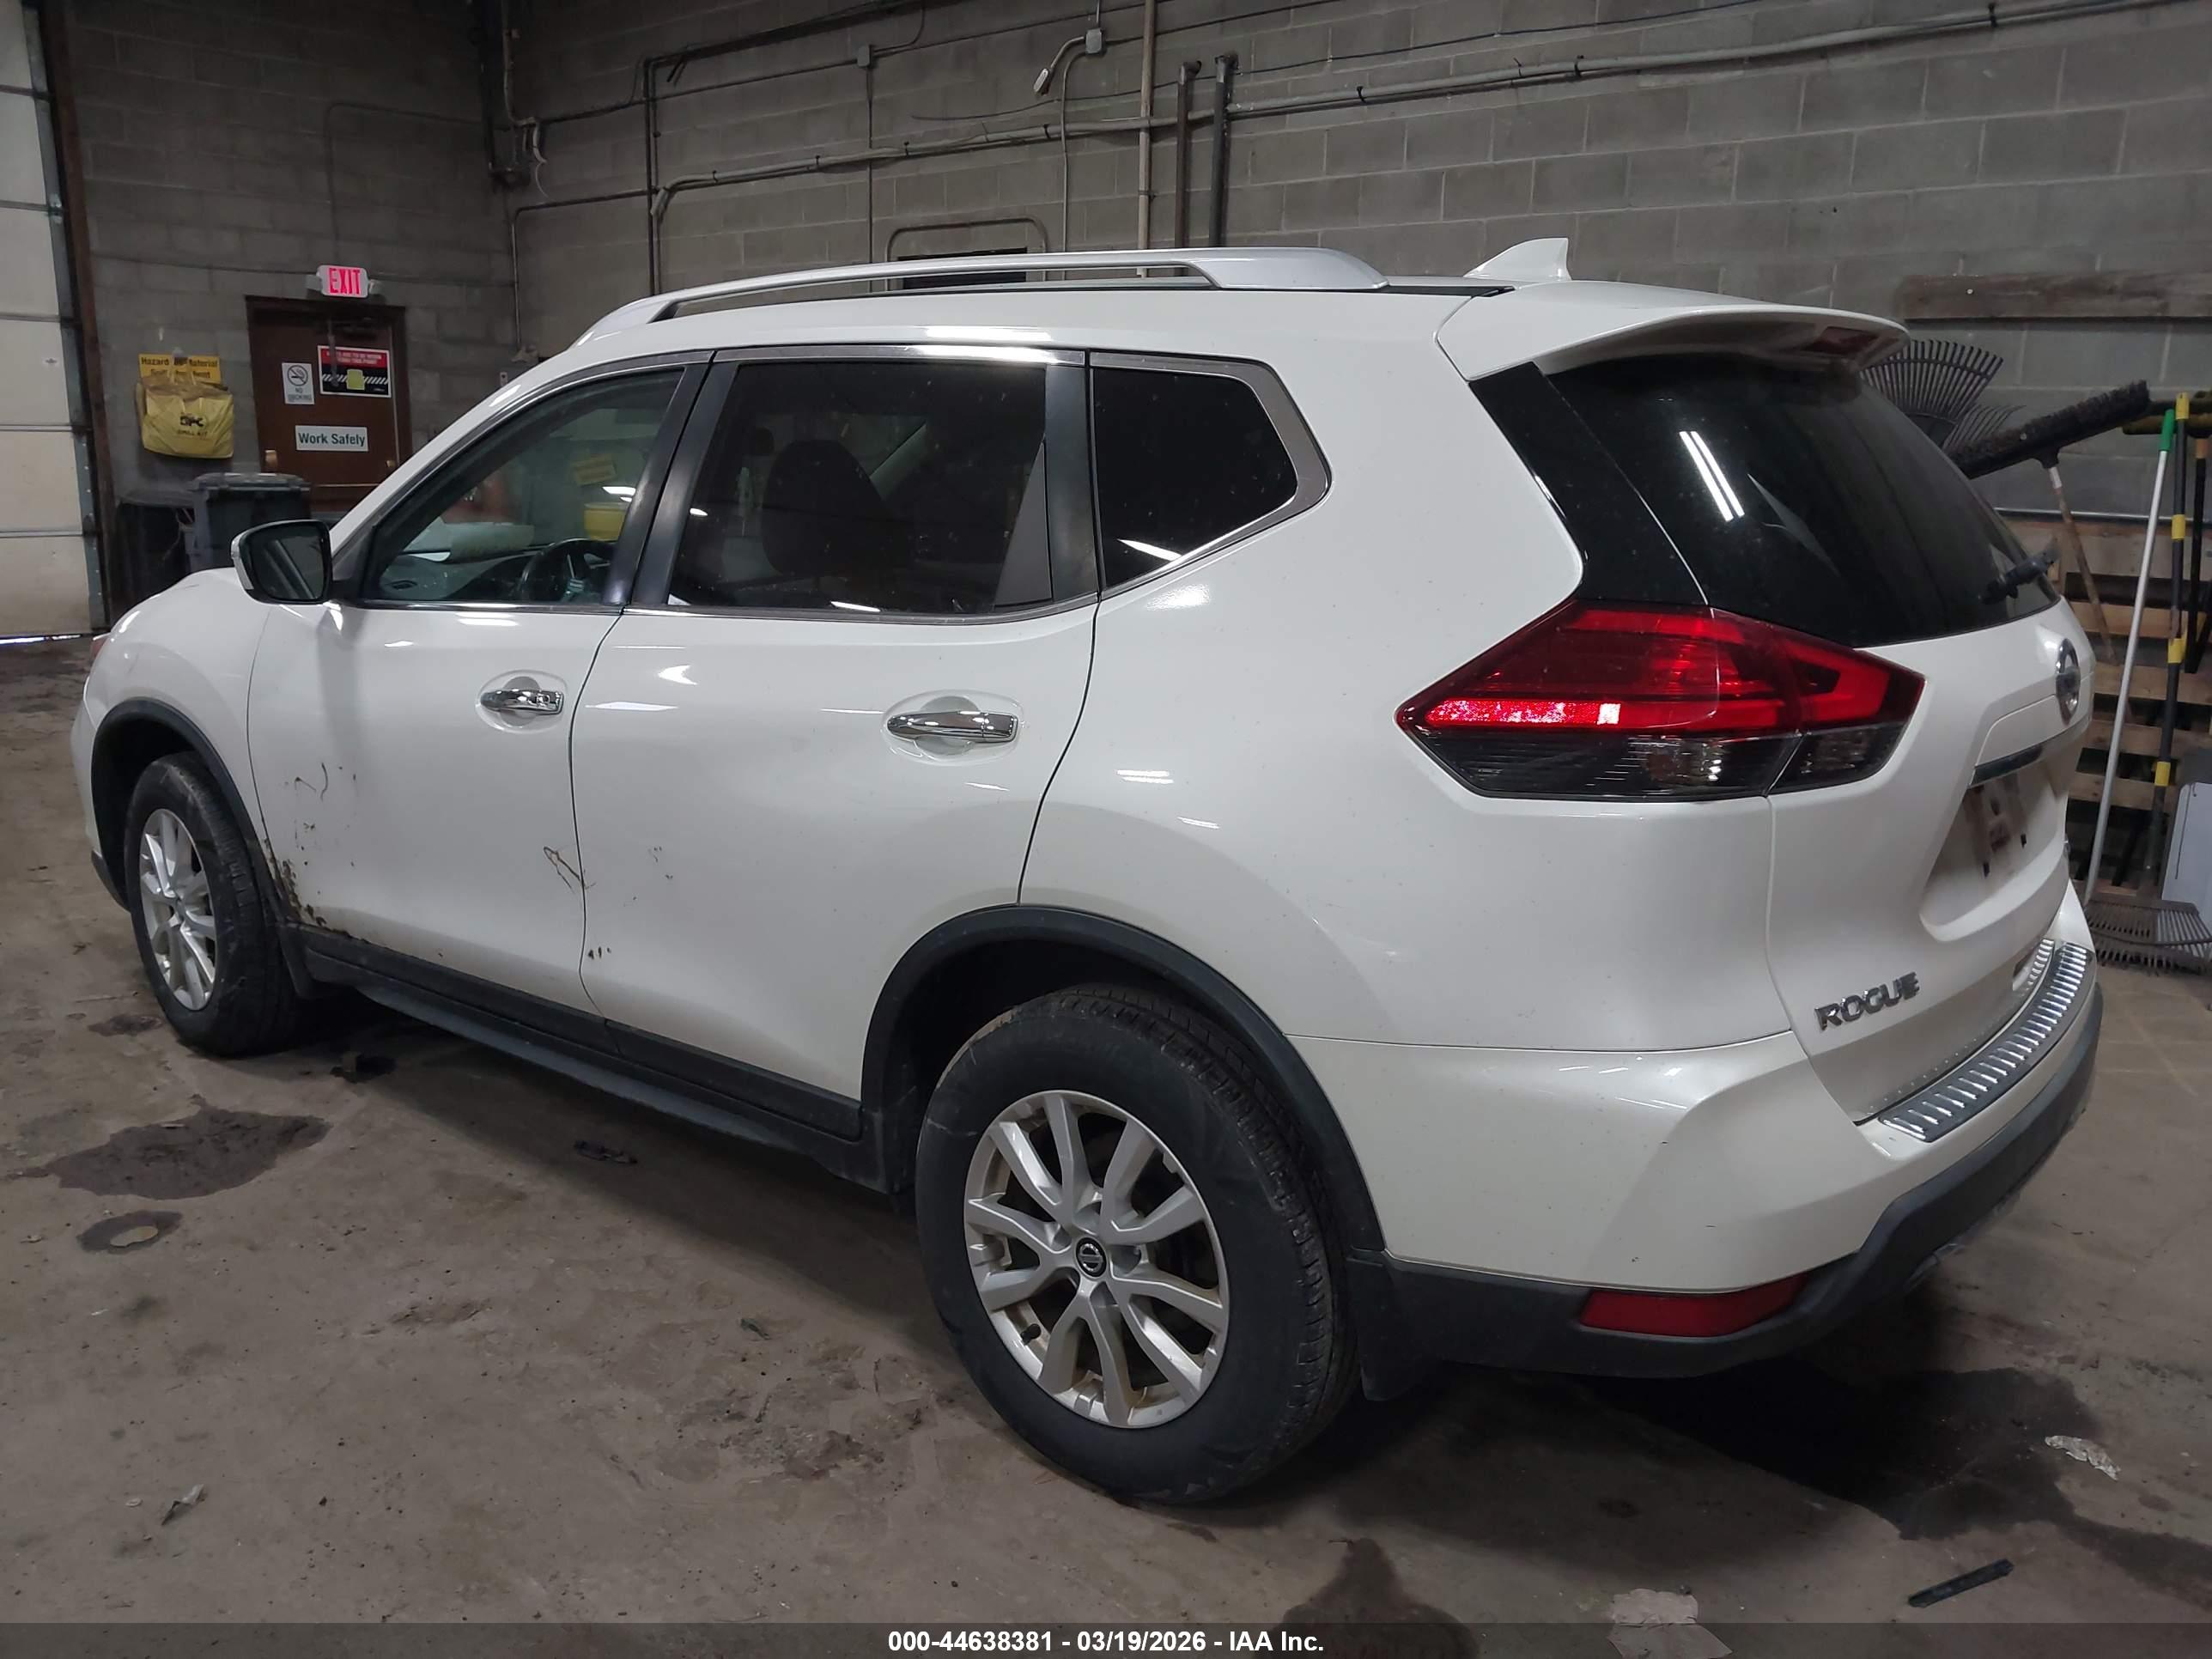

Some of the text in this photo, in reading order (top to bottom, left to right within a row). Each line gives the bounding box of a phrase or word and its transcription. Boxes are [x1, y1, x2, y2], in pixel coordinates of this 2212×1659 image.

[329, 268, 360, 295] EXIT
[298, 432, 365, 447] Work Safely
[1814, 972, 1920, 1031] ROGUE
